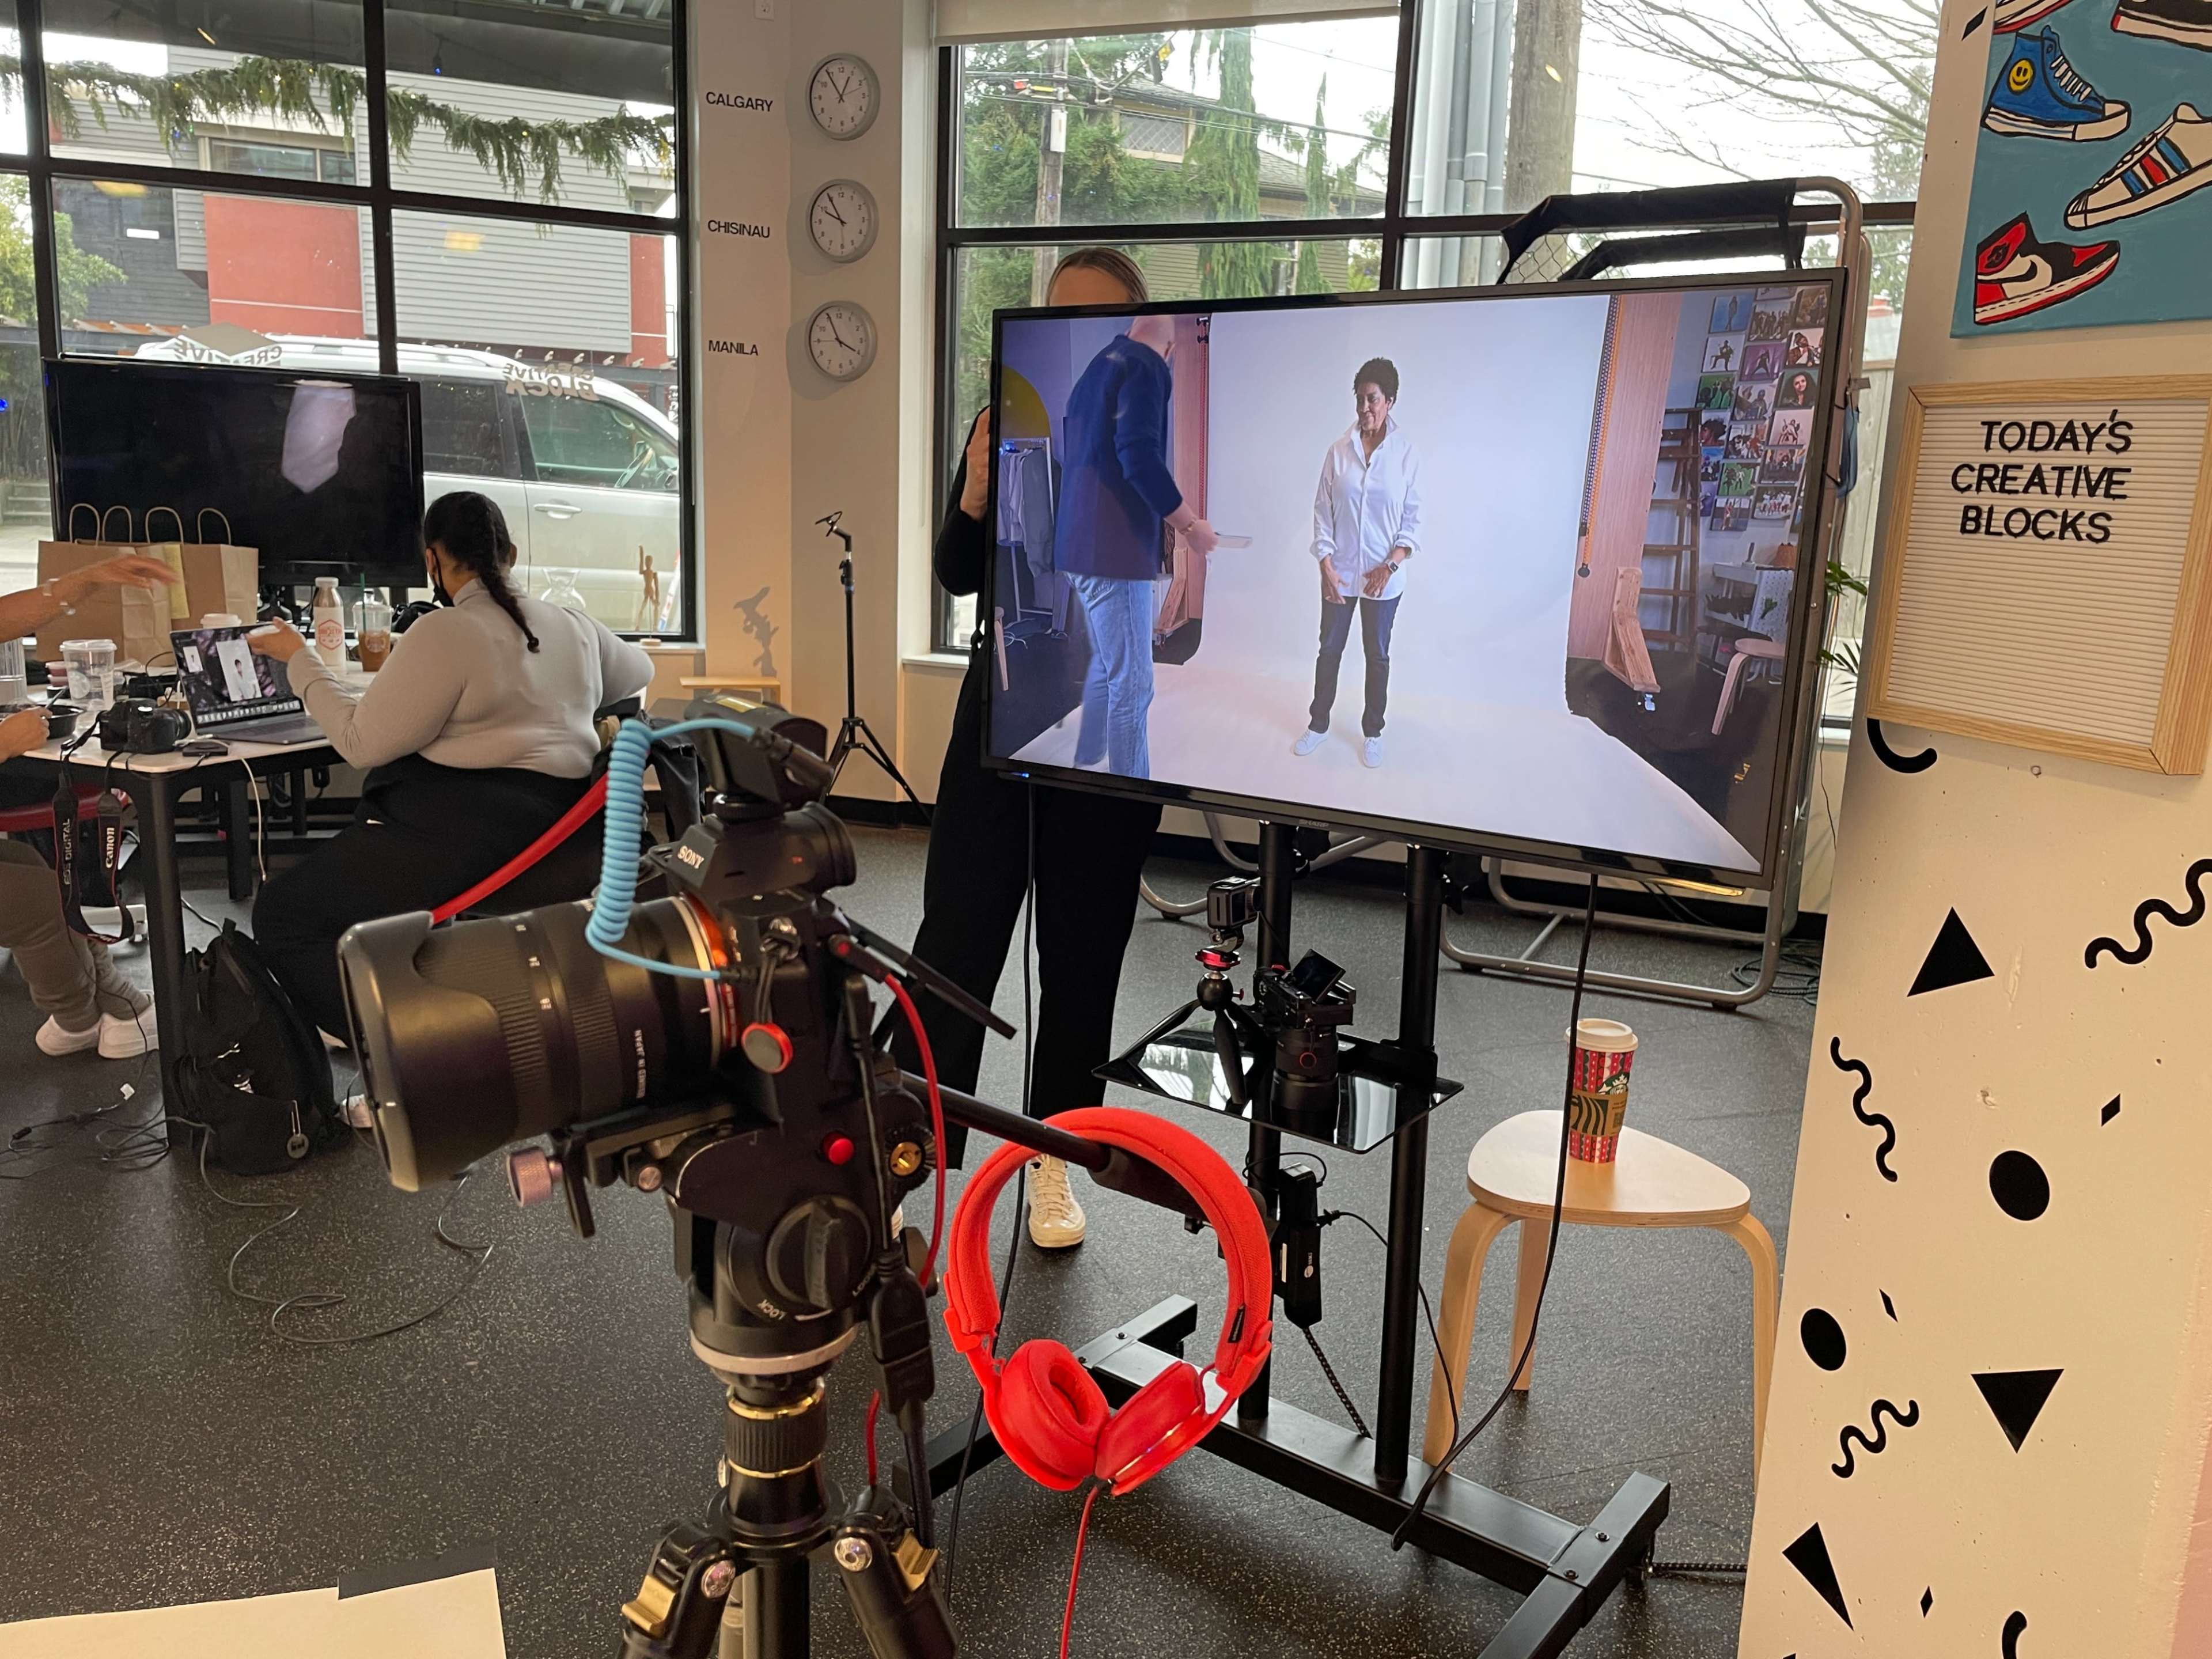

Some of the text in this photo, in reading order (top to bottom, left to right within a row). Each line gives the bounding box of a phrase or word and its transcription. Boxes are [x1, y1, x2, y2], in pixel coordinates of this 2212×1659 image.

[706, 92, 773, 112] CALGARY
[708, 220, 770, 238] CHISINAU
[709, 340, 758, 356] MANILA
[1981, 409, 2134, 454] TODAY'S
[1951, 463, 2131, 500] CREATIVE
[1960, 505, 2112, 543] BLOCKS
[62, 818, 73, 861] DIGITAL
[105, 827, 115, 869] Canon
[677, 845, 704, 869] SONY
[634, 1029, 645, 1056] JAPAN
[757, 1298, 787, 1320] LOCK
